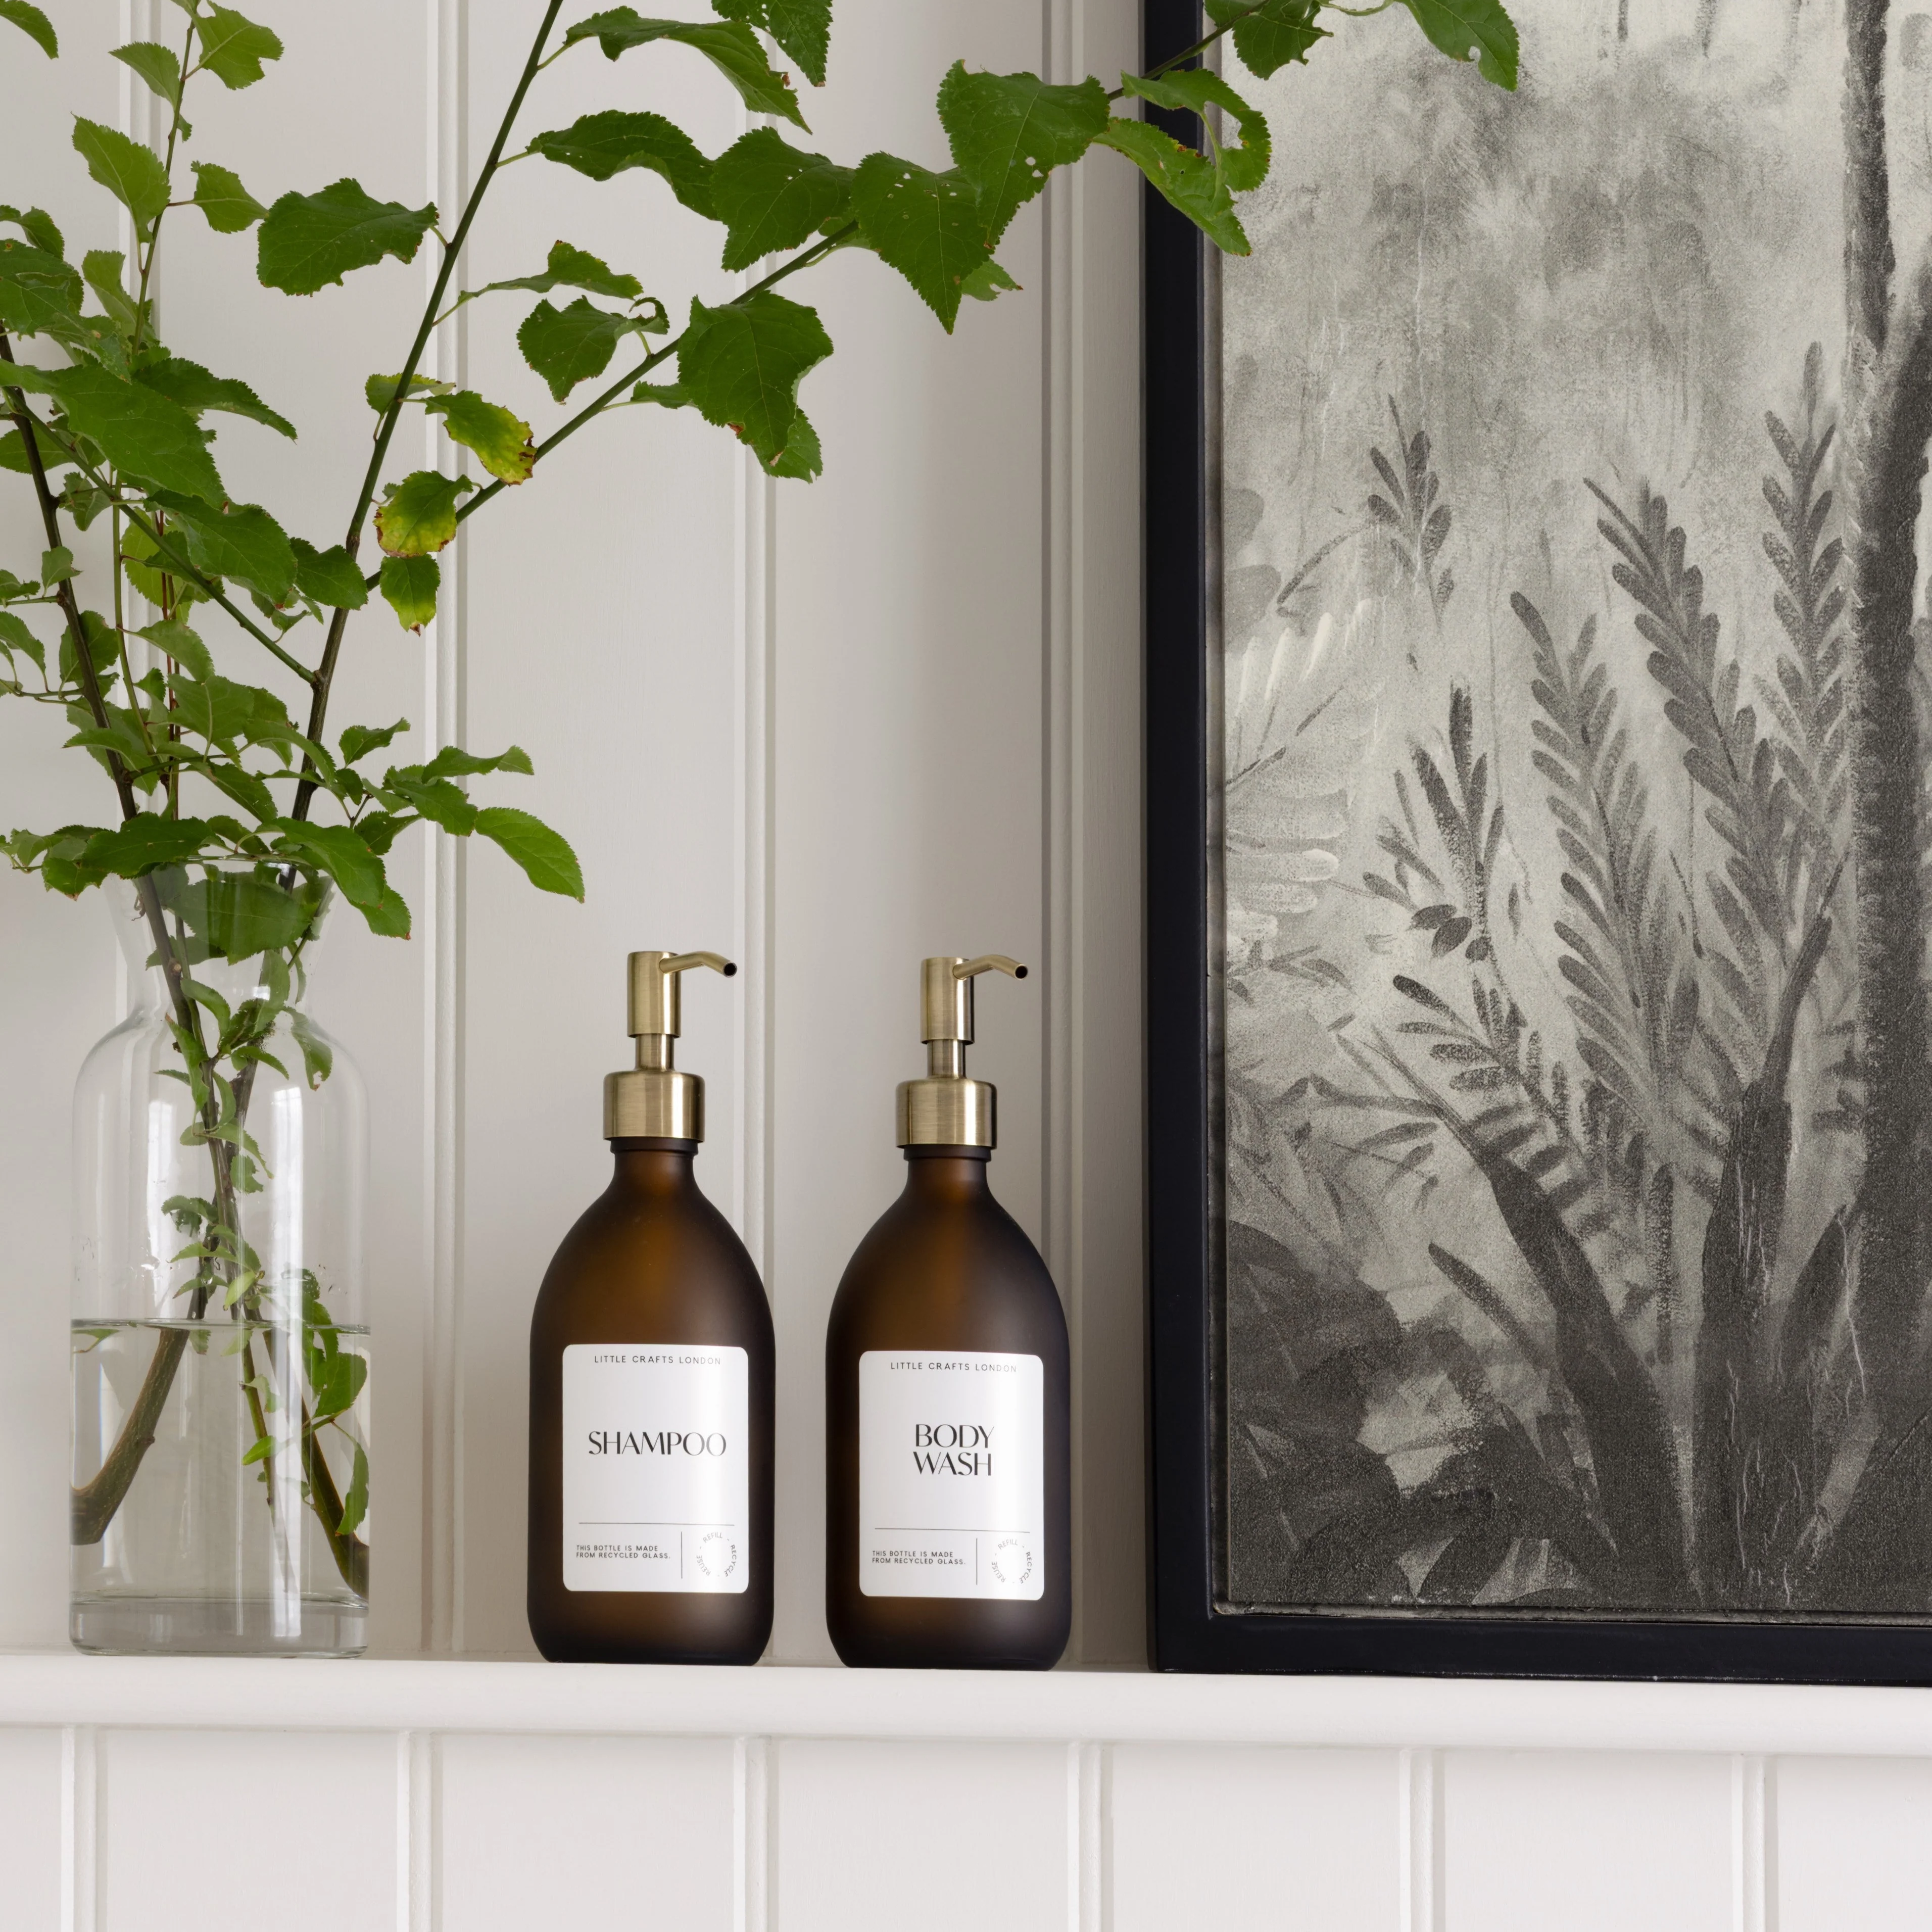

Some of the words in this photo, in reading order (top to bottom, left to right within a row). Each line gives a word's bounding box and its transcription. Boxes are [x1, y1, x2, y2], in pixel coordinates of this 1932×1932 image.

[632, 1356, 673, 1364] CRAFTS
[679, 1357, 721, 1365] LONDON
[891, 1362, 923, 1370] LITTLE
[929, 1363, 970, 1371] CRAFTS
[975, 1364, 1017, 1373] LONDON
[589, 1431, 727, 1457] SHAMPOO
[915, 1424, 994, 1448] BODY
[913, 1452, 992, 1476] WASH
[703, 1532, 722, 1543] REFILL
[998, 1538, 1018, 1550] REFILL
[696, 1555, 711, 1576] REUSE
[724, 1544, 737, 1577] RECYCLE
[1019, 1552, 1032, 1584] RECYCLE
[991, 1561, 1006, 1583] REUSE
